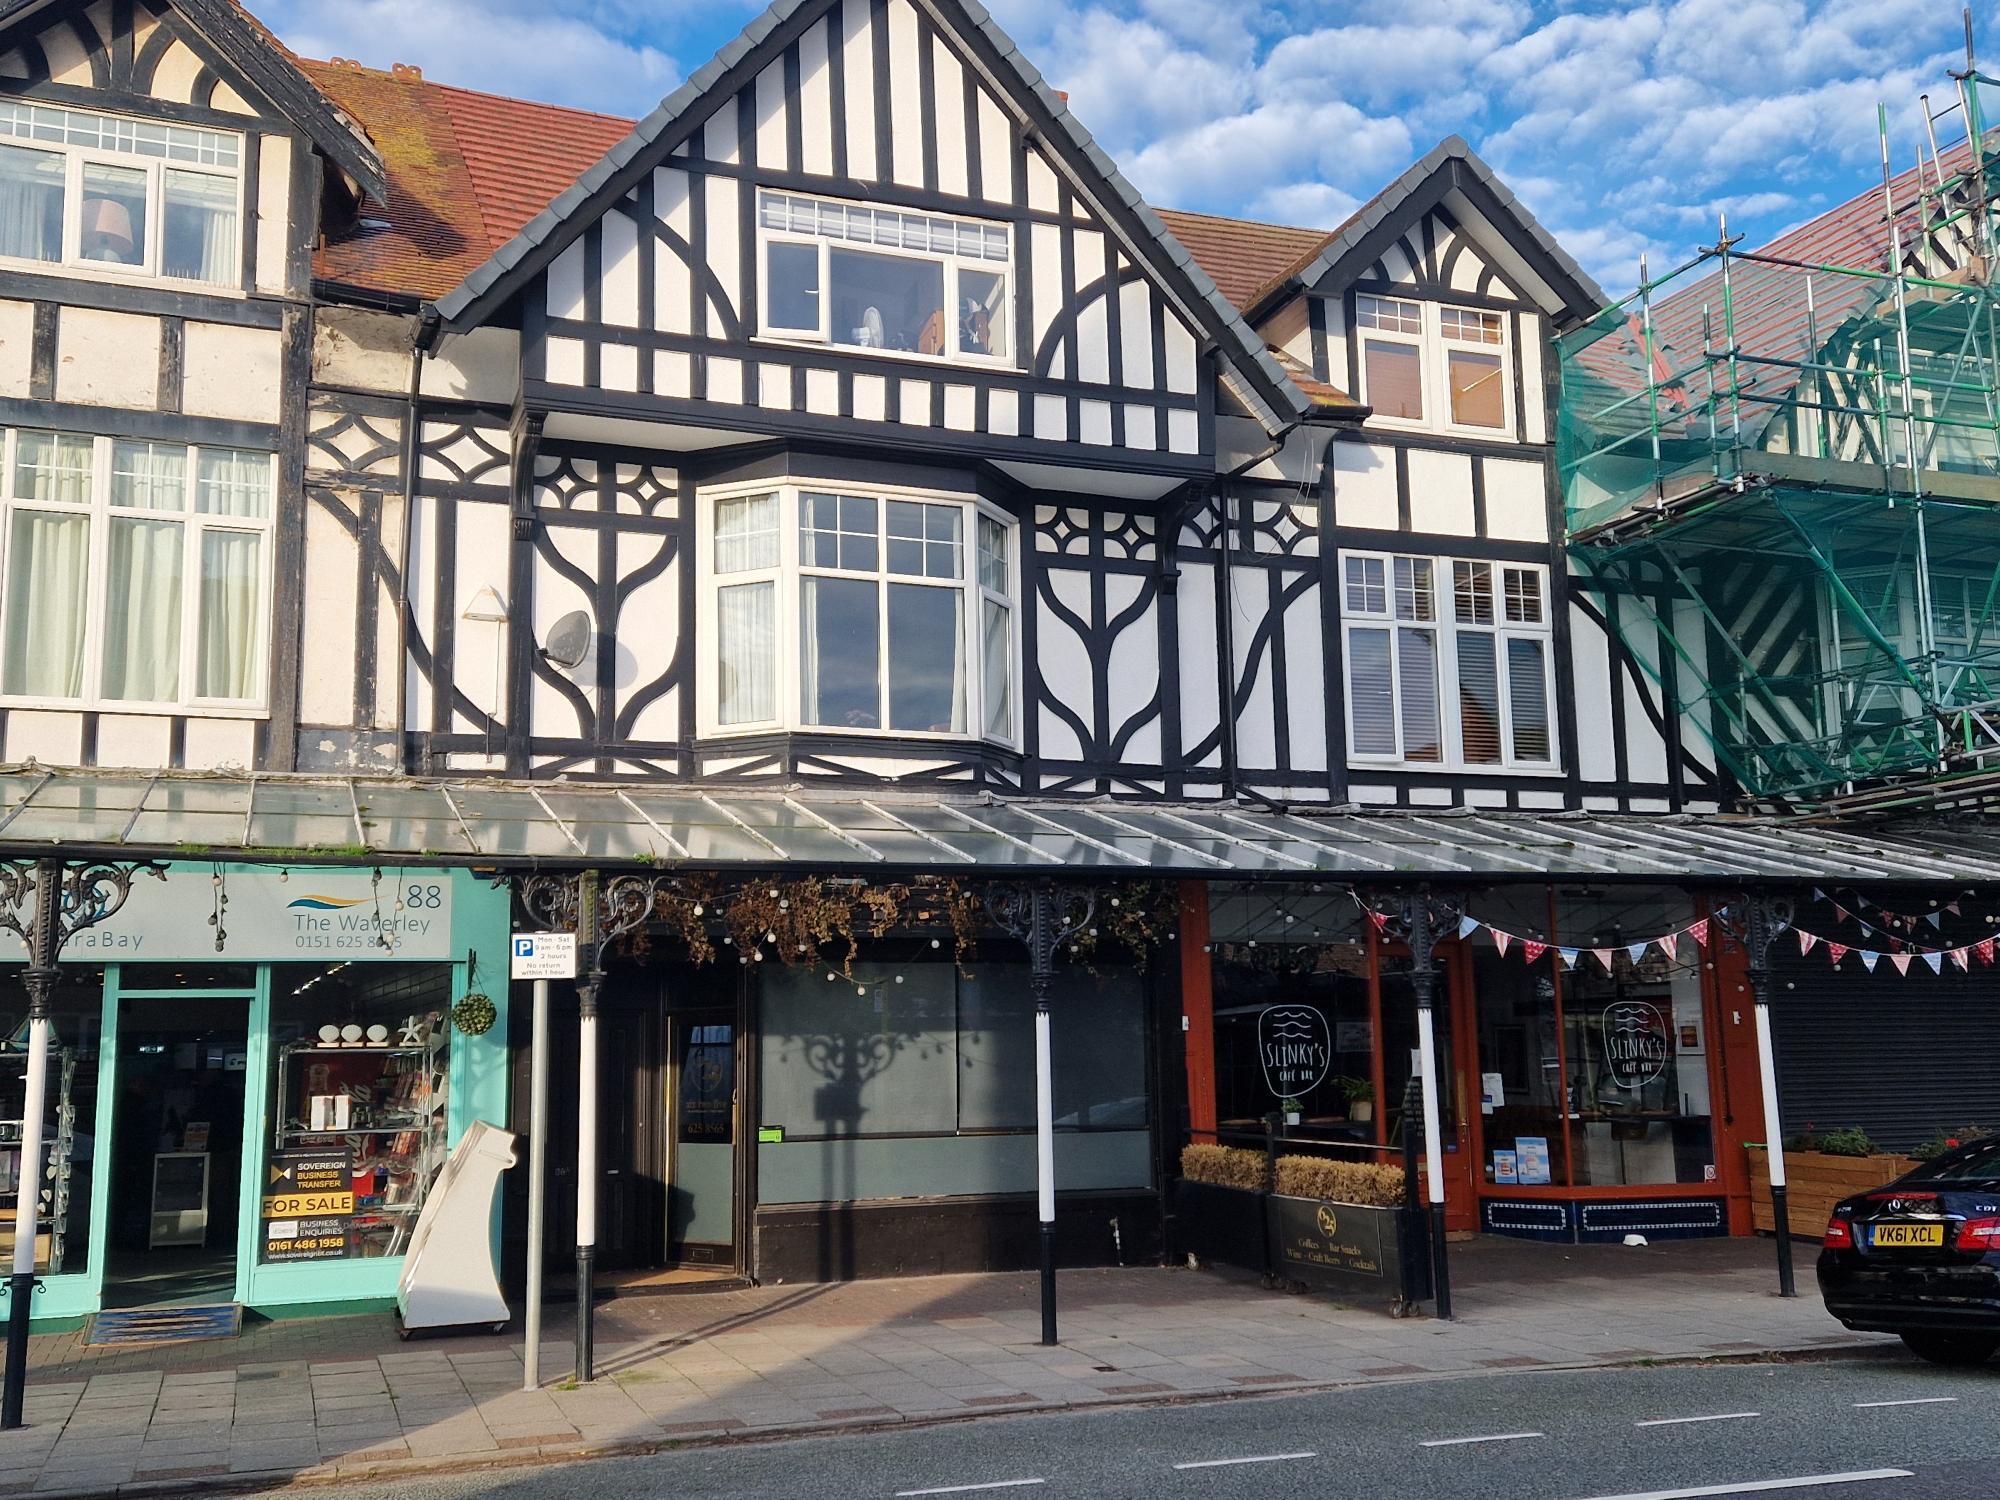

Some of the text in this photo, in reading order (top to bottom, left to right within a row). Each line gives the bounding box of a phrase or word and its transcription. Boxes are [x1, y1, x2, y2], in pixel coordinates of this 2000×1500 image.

[407, 884, 441, 909] 88
[293, 914, 430, 936] The Waverley
[295, 935, 402, 949] 0151 625 85
[1266, 1042, 1326, 1068] SLINKY'S
[1610, 1036, 1663, 1060] SLINKY'S
[297, 1161, 346, 1171] SOVEREIGN
[297, 1170, 339, 1180] BUSINESS
[297, 1180, 341, 1189] TRANSFER
[263, 1196, 351, 1214] FOR SALE
[300, 1219, 339, 1228] BUSINESS
[1879, 1226, 1936, 1243] VK61 XCL
[268, 1237, 344, 1251] 0161 486 1958
[1298, 1238, 1320, 1250] Coffees
[1349, 1258, 1378, 1271] Cocktails
